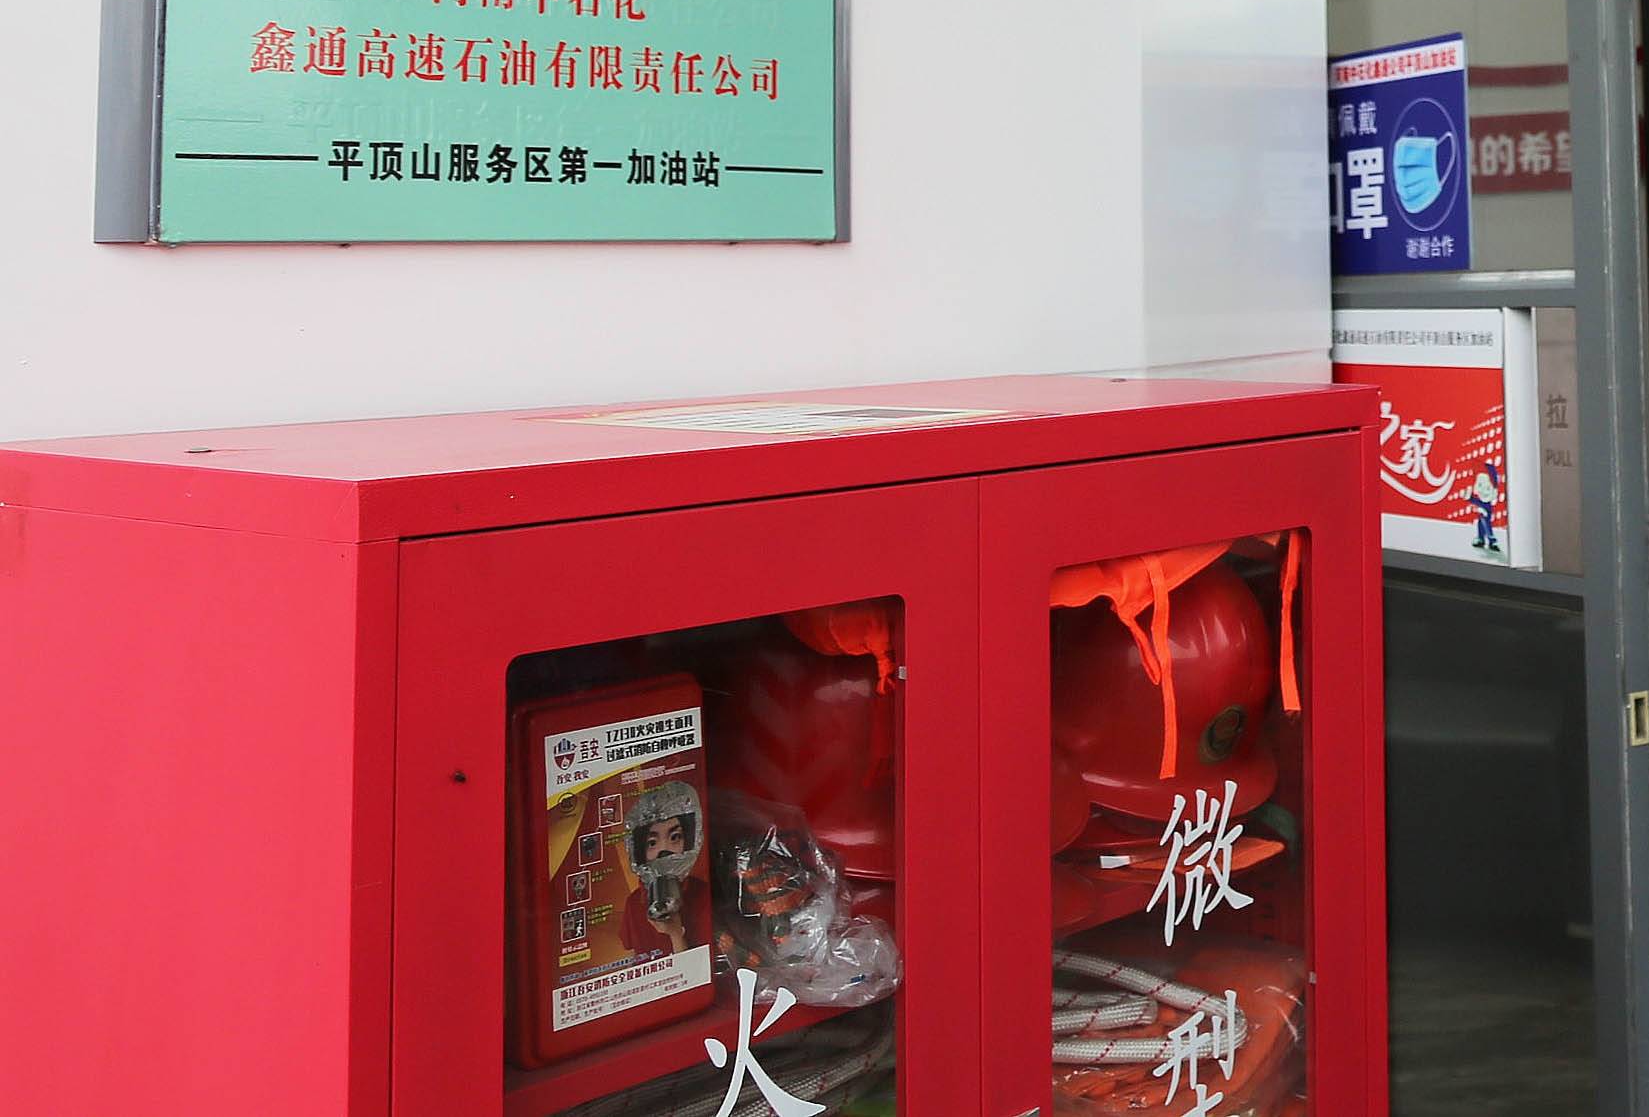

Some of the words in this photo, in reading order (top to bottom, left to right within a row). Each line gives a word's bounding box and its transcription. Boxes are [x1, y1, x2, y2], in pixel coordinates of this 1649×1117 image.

[249, 20, 781, 102] 鑫通高速石油有限责任公司
[1329, 100, 1378, 138] 佩戴
[327, 139, 721, 187] 平顶山服务区第一加油站
[1546, 393, 1569, 430] 拉
[1545, 448, 1574, 468] PULL
[1146, 779, 1255, 1117] 微型
[703, 967, 828, 1117] 火
